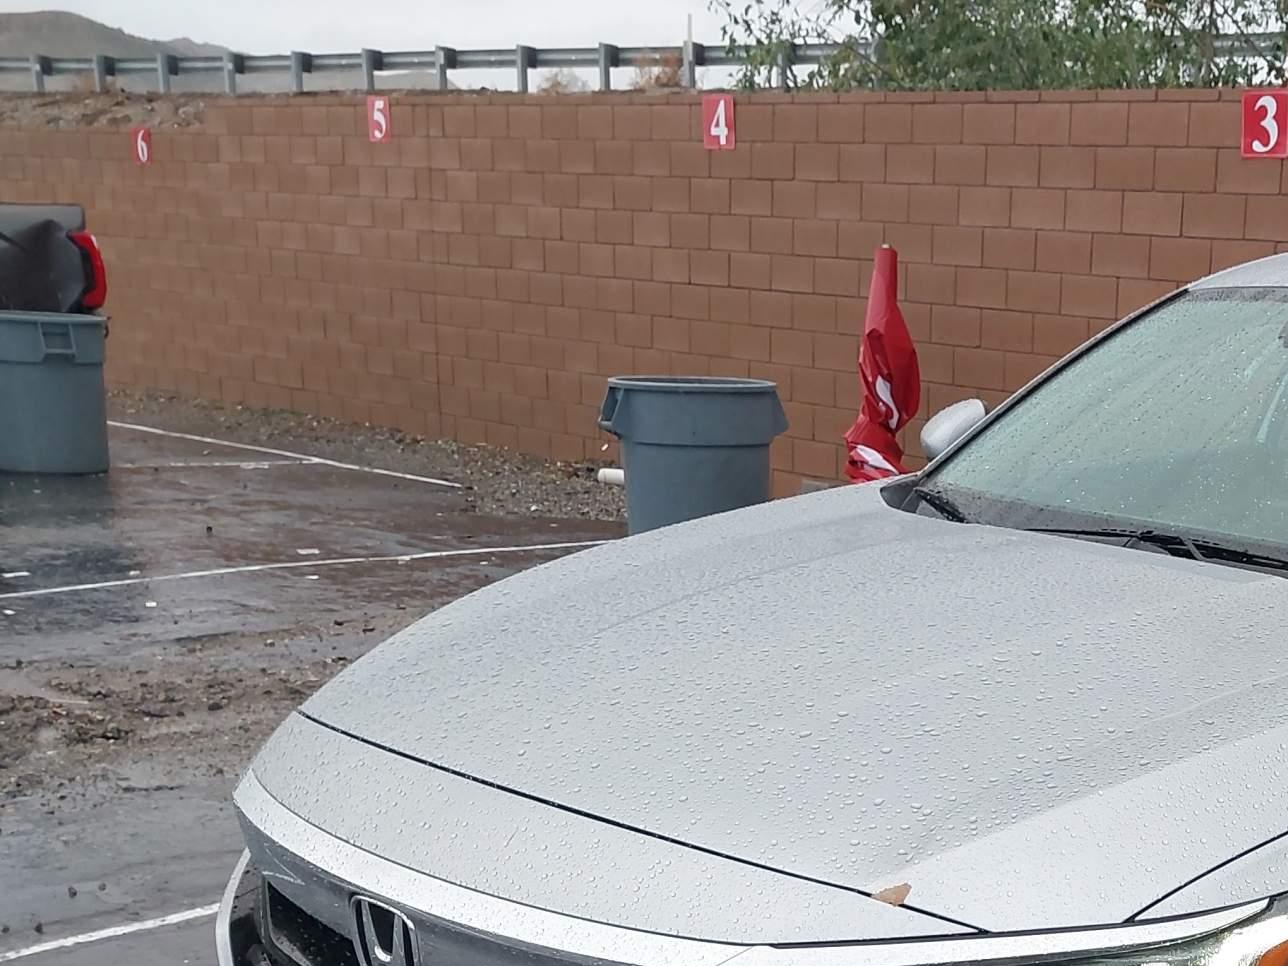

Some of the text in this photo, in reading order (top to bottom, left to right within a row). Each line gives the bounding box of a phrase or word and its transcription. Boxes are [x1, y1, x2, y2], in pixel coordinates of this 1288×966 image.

[372, 100, 386, 139] 5
[709, 99, 729, 146] 4
[1251, 95, 1279, 153] 3
[137, 129, 148, 163] 6
